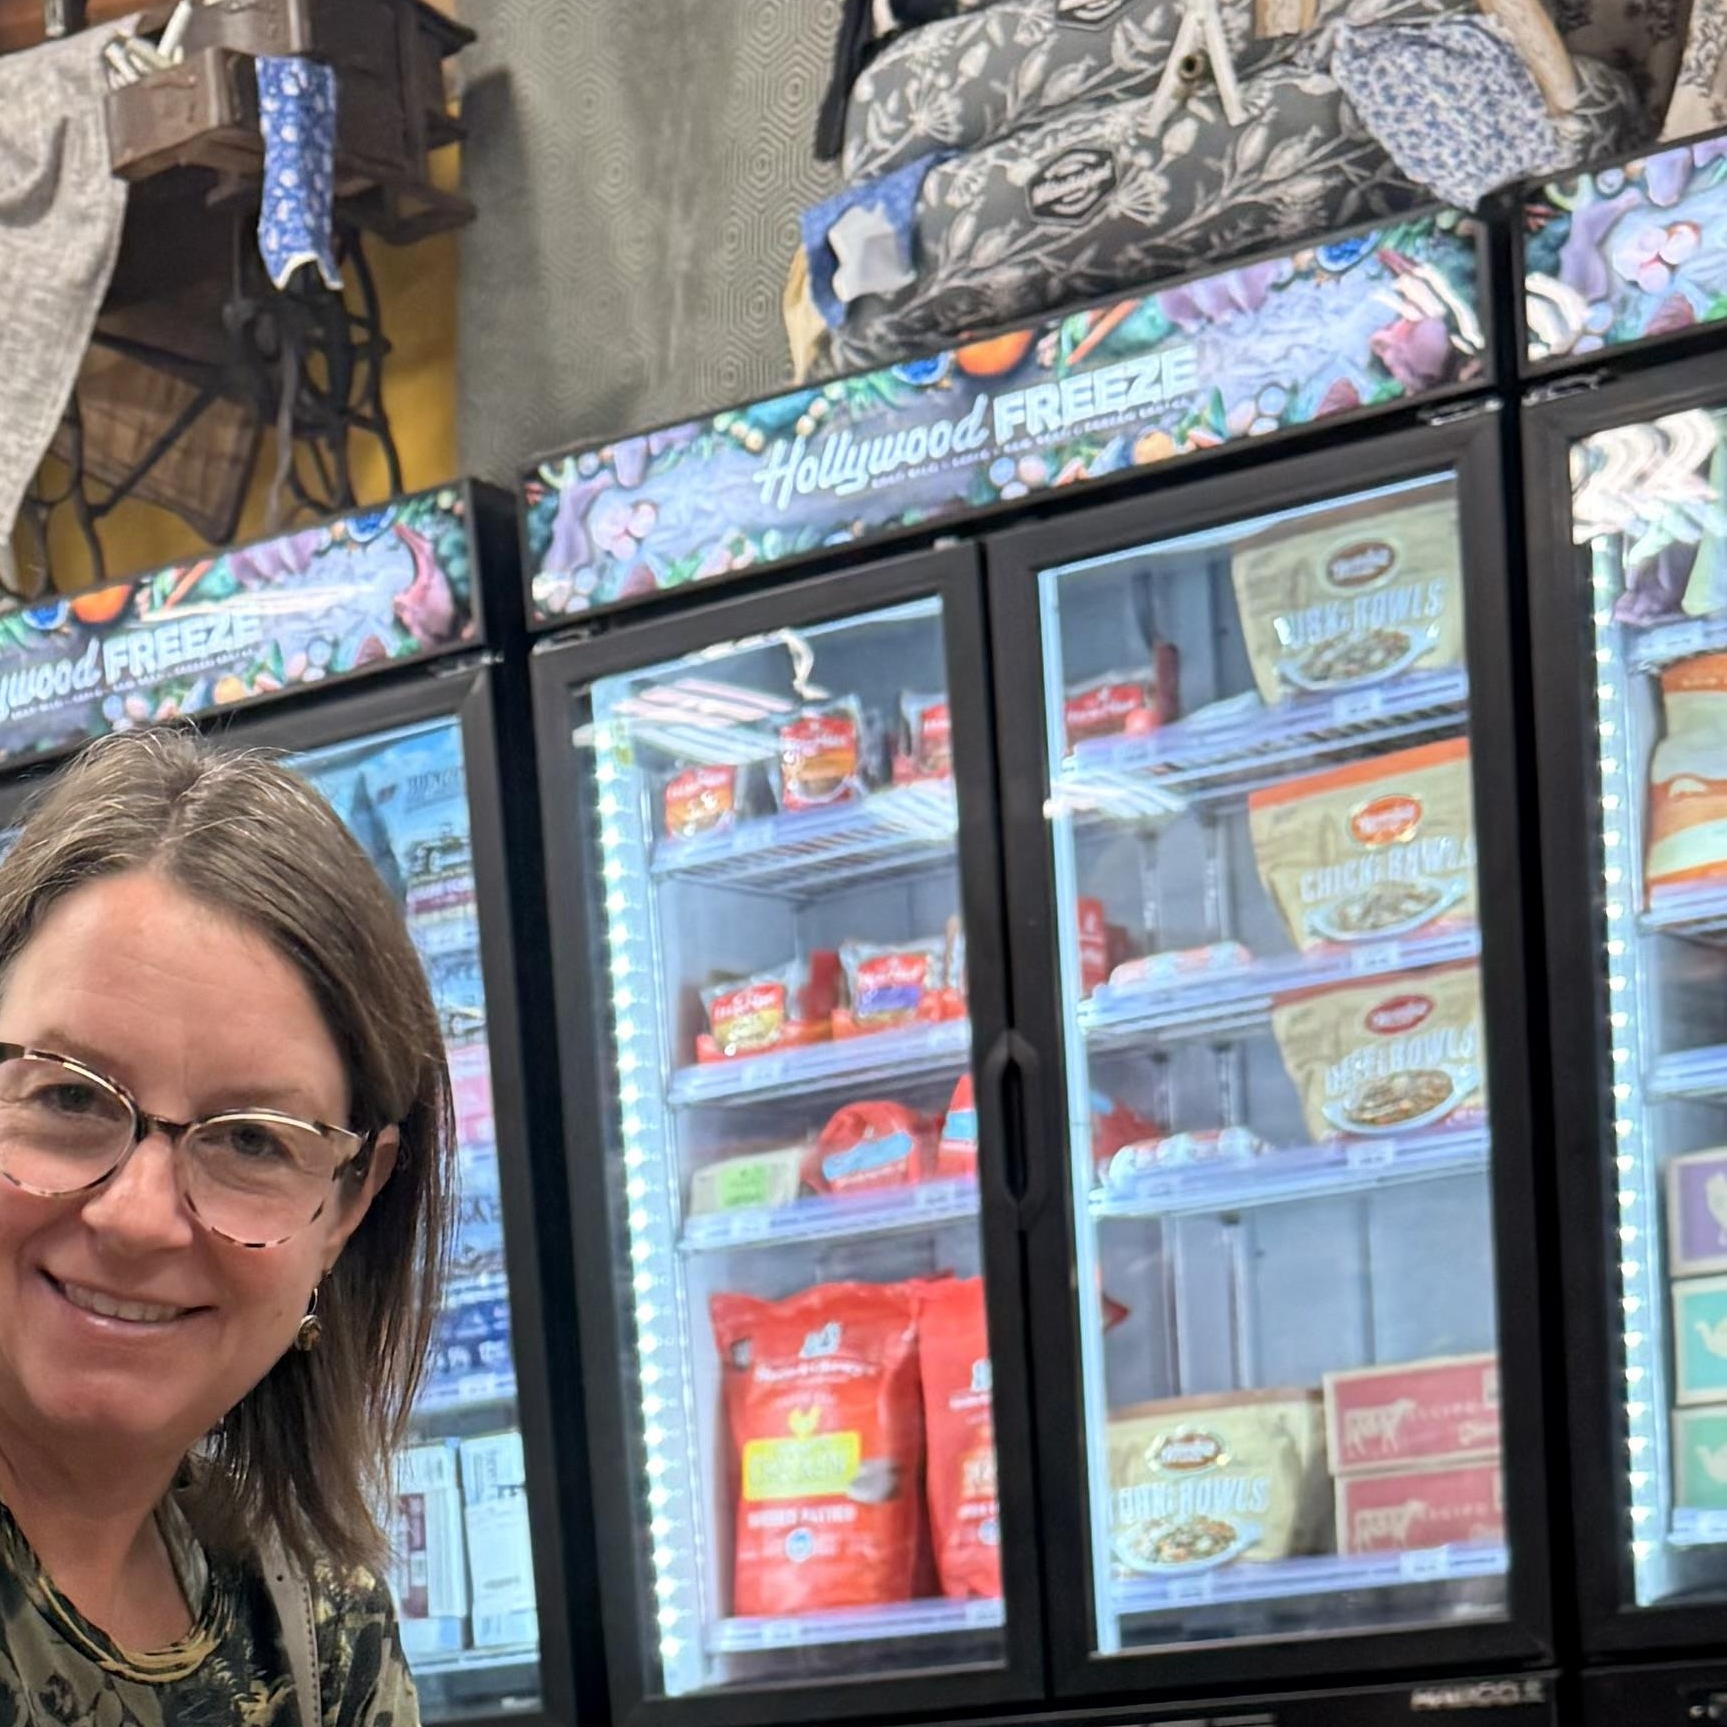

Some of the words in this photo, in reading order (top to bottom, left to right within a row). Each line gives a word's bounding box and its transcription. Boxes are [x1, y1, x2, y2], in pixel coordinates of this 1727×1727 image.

[753, 393, 988, 511] Hollywood
[992, 344, 1199, 445] FREEZE
[102, 613, 264, 683] FREEZE
